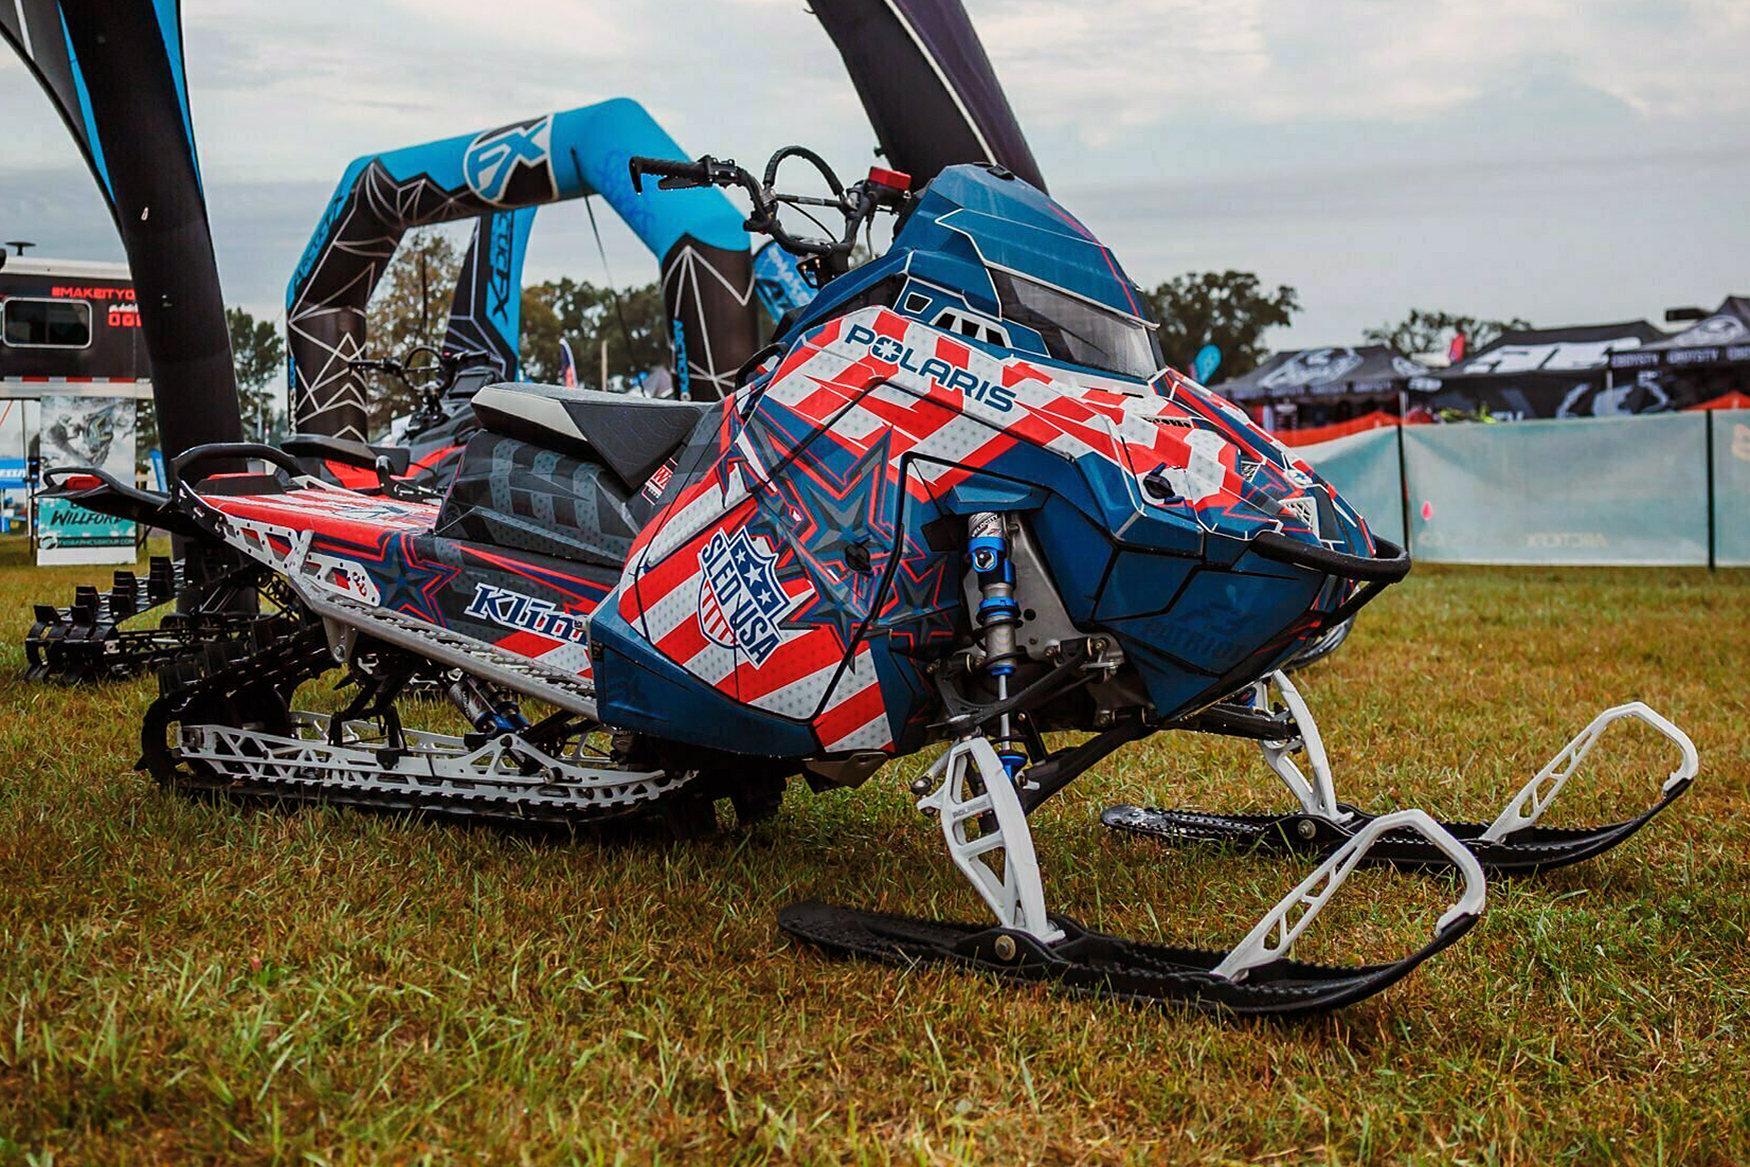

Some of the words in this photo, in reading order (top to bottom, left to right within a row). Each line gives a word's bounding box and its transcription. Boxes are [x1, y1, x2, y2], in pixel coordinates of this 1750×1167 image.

[467, 120, 549, 200] FX
[844, 323, 1017, 413] POLARIS
[701, 533, 742, 606] SLED
[729, 598, 780, 665] USA
